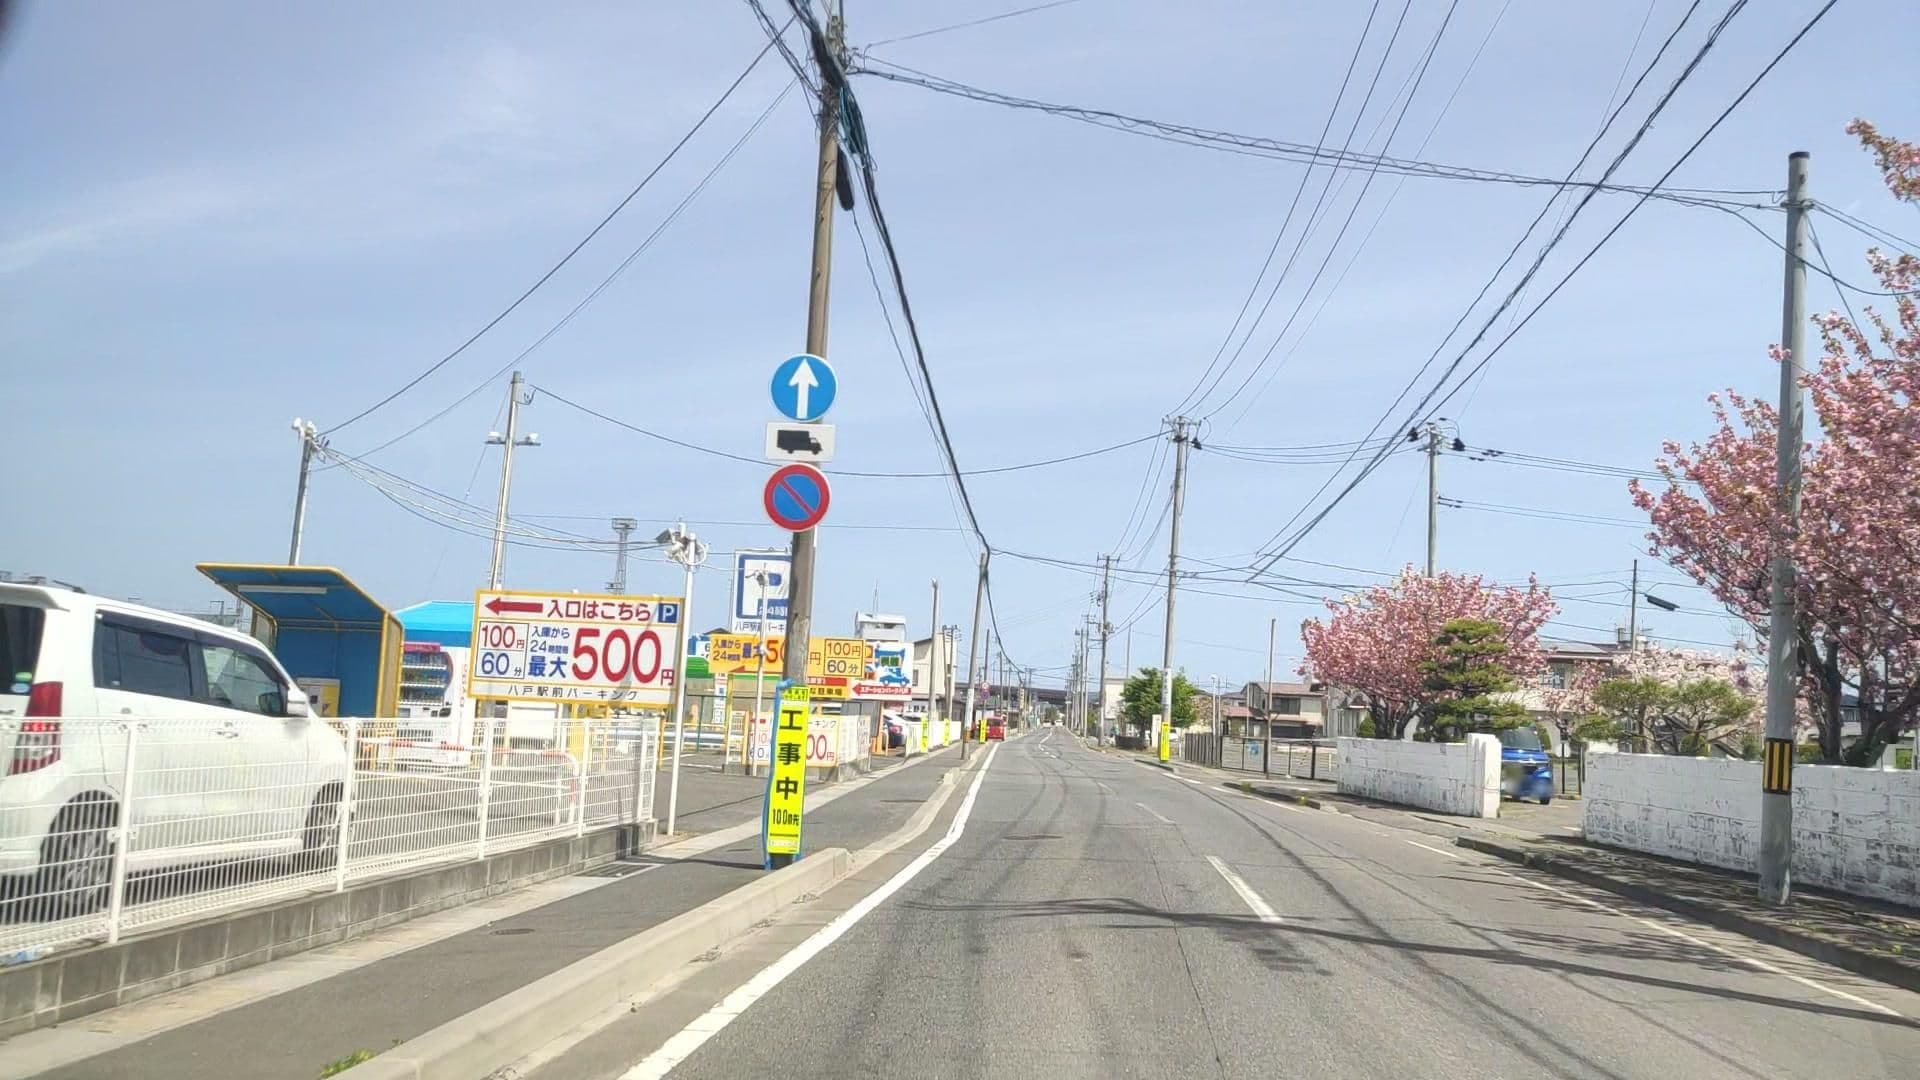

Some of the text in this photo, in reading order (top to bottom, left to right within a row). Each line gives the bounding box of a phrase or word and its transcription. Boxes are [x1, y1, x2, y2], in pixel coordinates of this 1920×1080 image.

[547, 600, 651, 621] 入口はこちら
[481, 625, 525, 649] 100円
[572, 628, 674, 686] 500円
[810, 651, 821, 666] 円
[827, 642, 861, 657] 100円
[481, 652, 522, 677] 60分
[528, 655, 567, 678] 最大
[827, 659, 859, 674] 60分
[776, 709, 803, 801] 工事中
